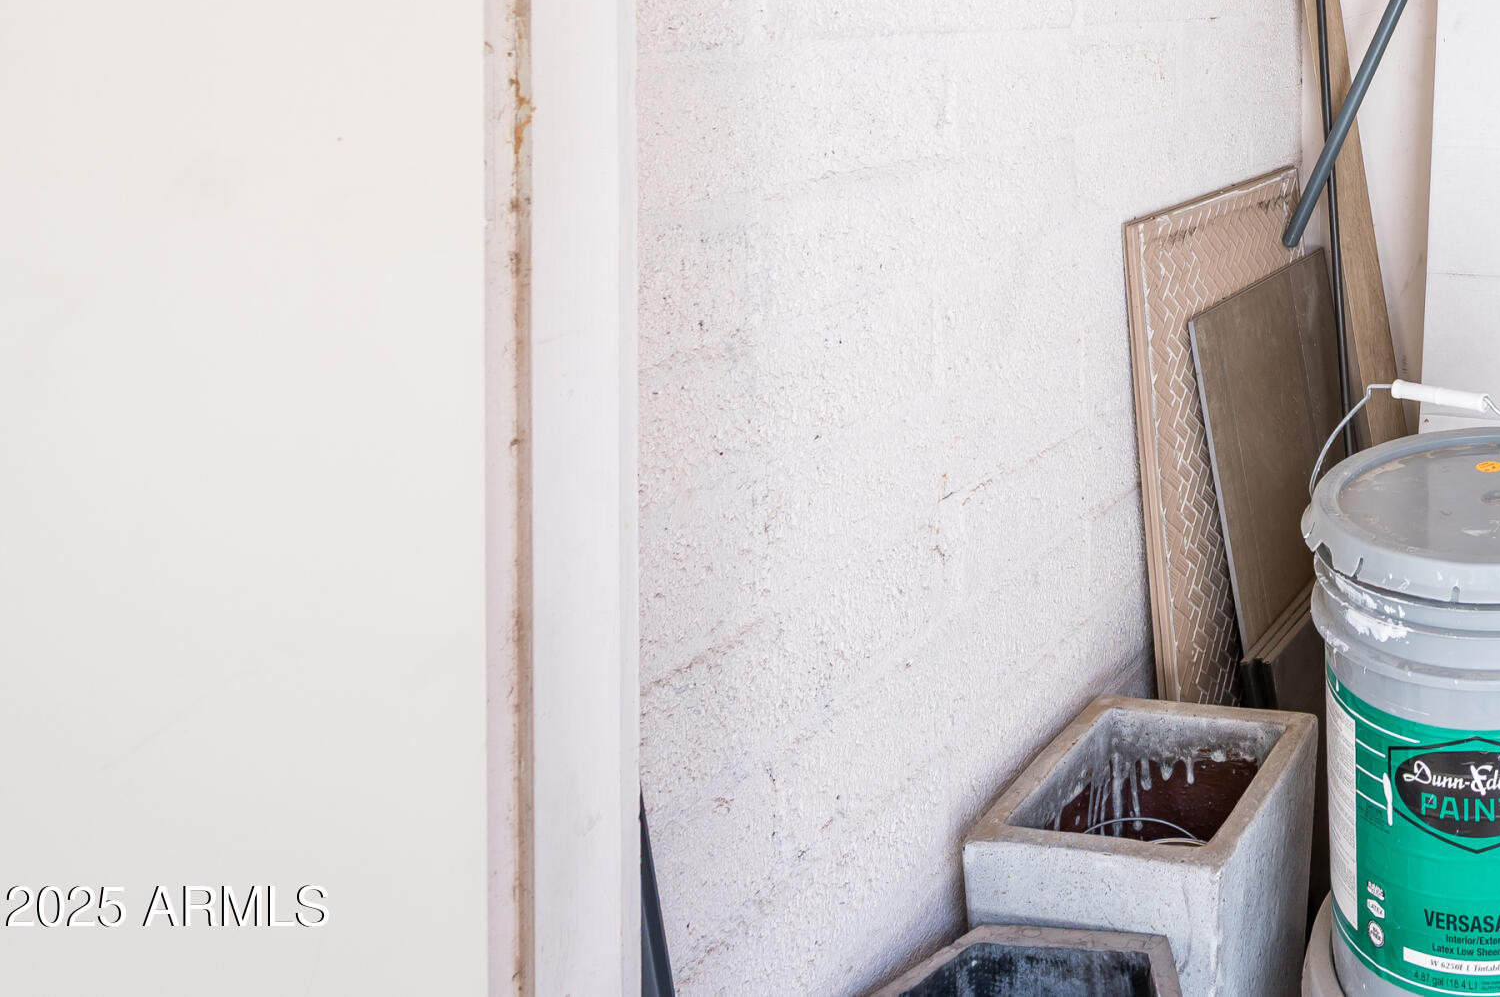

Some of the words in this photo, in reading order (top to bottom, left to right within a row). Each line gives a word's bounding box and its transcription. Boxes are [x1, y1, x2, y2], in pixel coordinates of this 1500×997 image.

[1432, 943, 1454, 955] Latex
[1457, 947, 1474, 956] Low
[1430, 959, 1438, 967] W
[1414, 971, 1430, 982] 4.87
[1432, 976, 1444, 987] gal
[1446, 977, 1466, 990] (18.4
